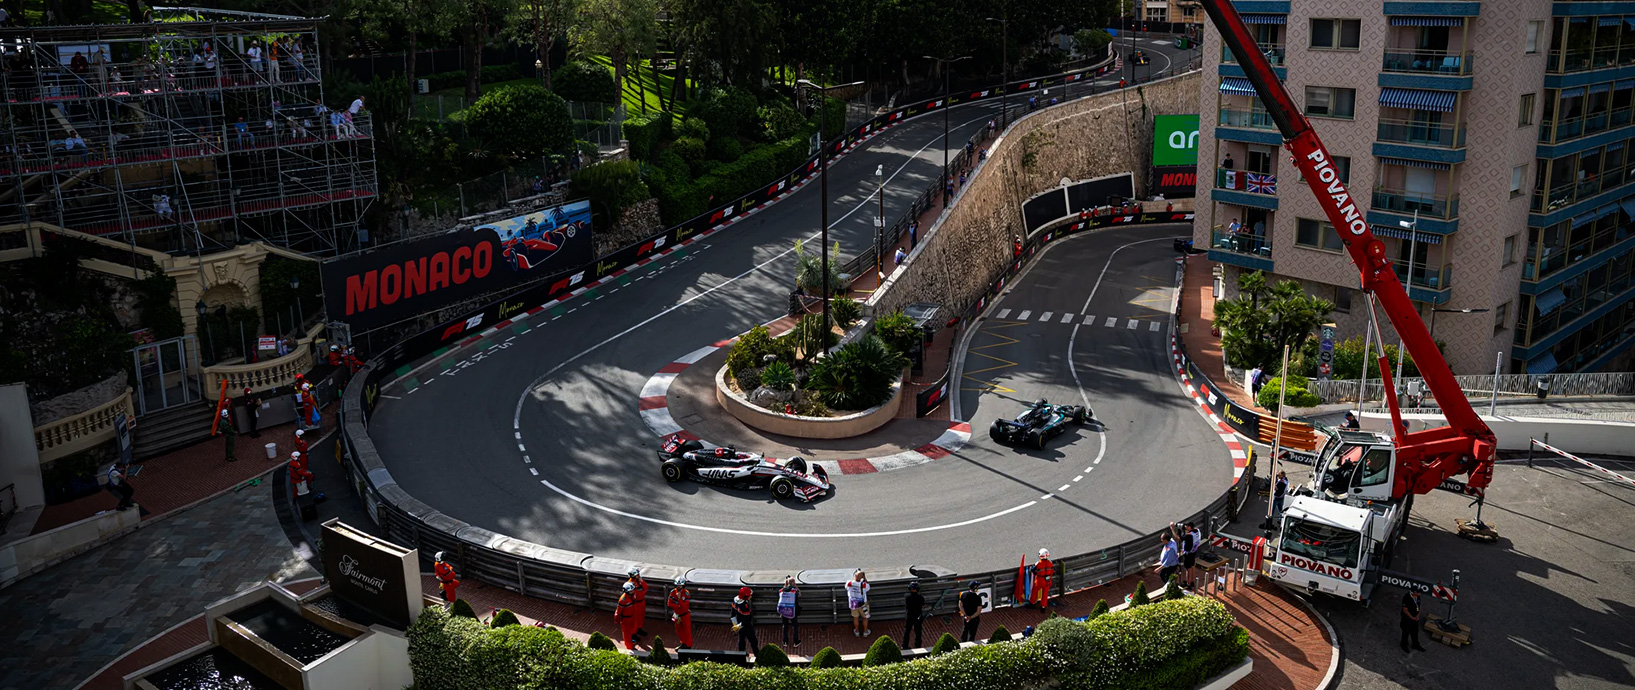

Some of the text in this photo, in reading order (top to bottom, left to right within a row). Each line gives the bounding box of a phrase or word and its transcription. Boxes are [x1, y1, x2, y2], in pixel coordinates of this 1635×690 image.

[1307, 148, 1366, 235] PIOVANO
[345, 240, 494, 317] MONACO
[702, 469, 740, 480] HAAS
[338, 554, 388, 591] Fairmont
[1281, 553, 1353, 581] PIOVANO
